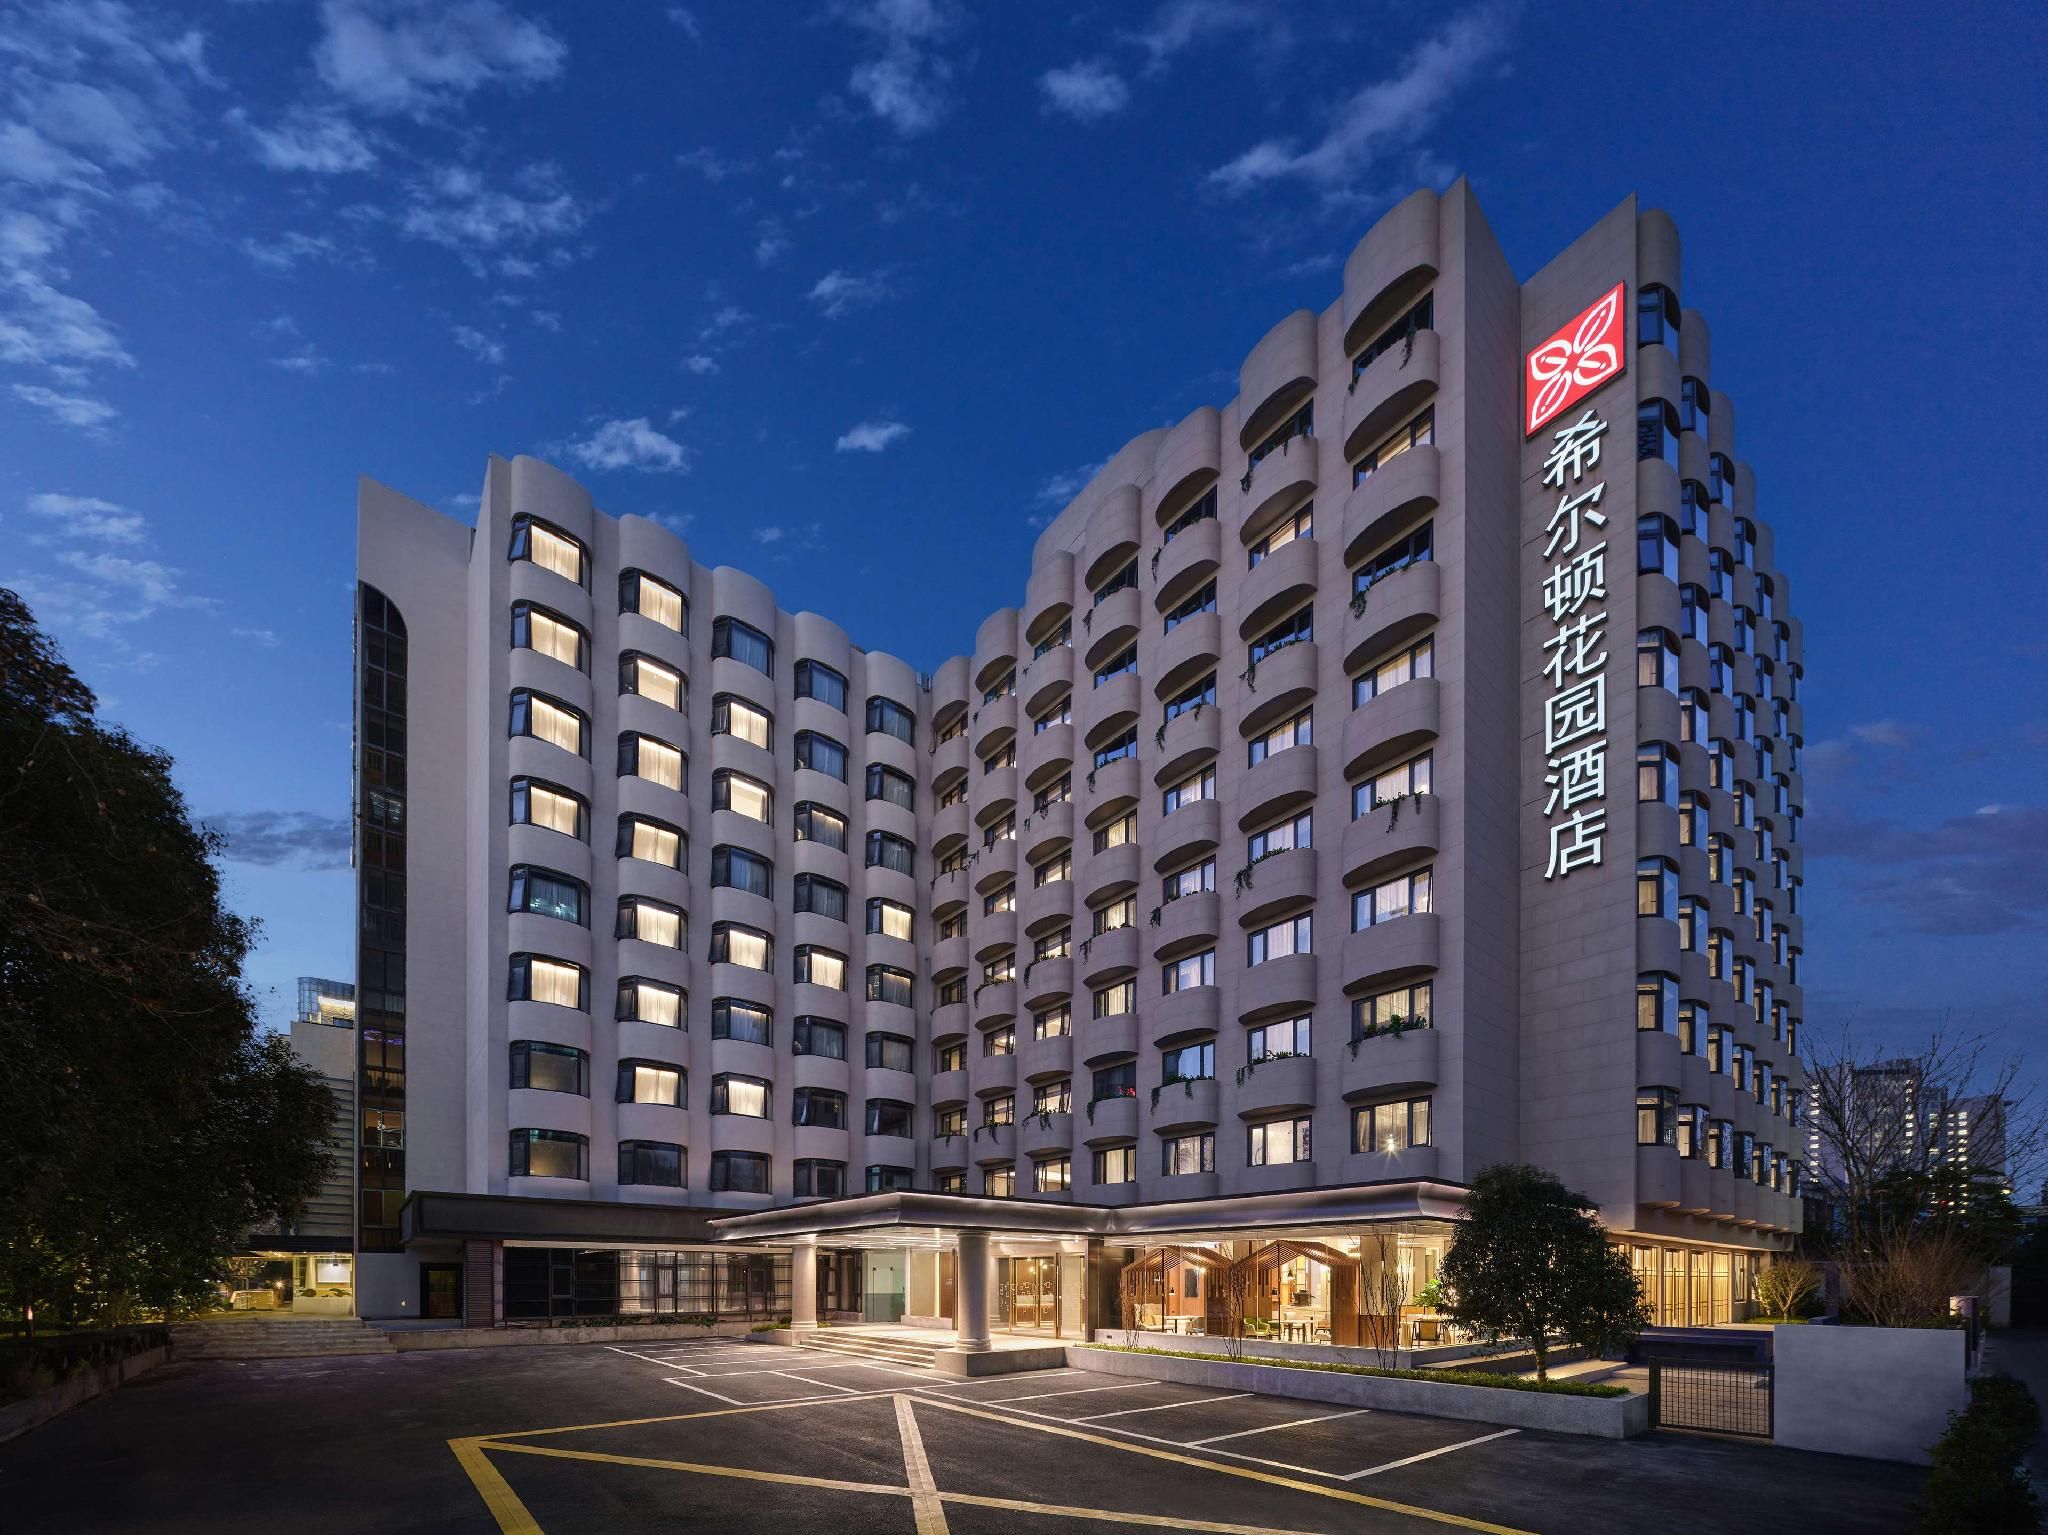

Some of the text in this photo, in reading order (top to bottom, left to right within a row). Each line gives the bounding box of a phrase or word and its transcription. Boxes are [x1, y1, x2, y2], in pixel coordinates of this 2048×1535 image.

[1542, 409, 1608, 879] 希尔顿花园酒店
